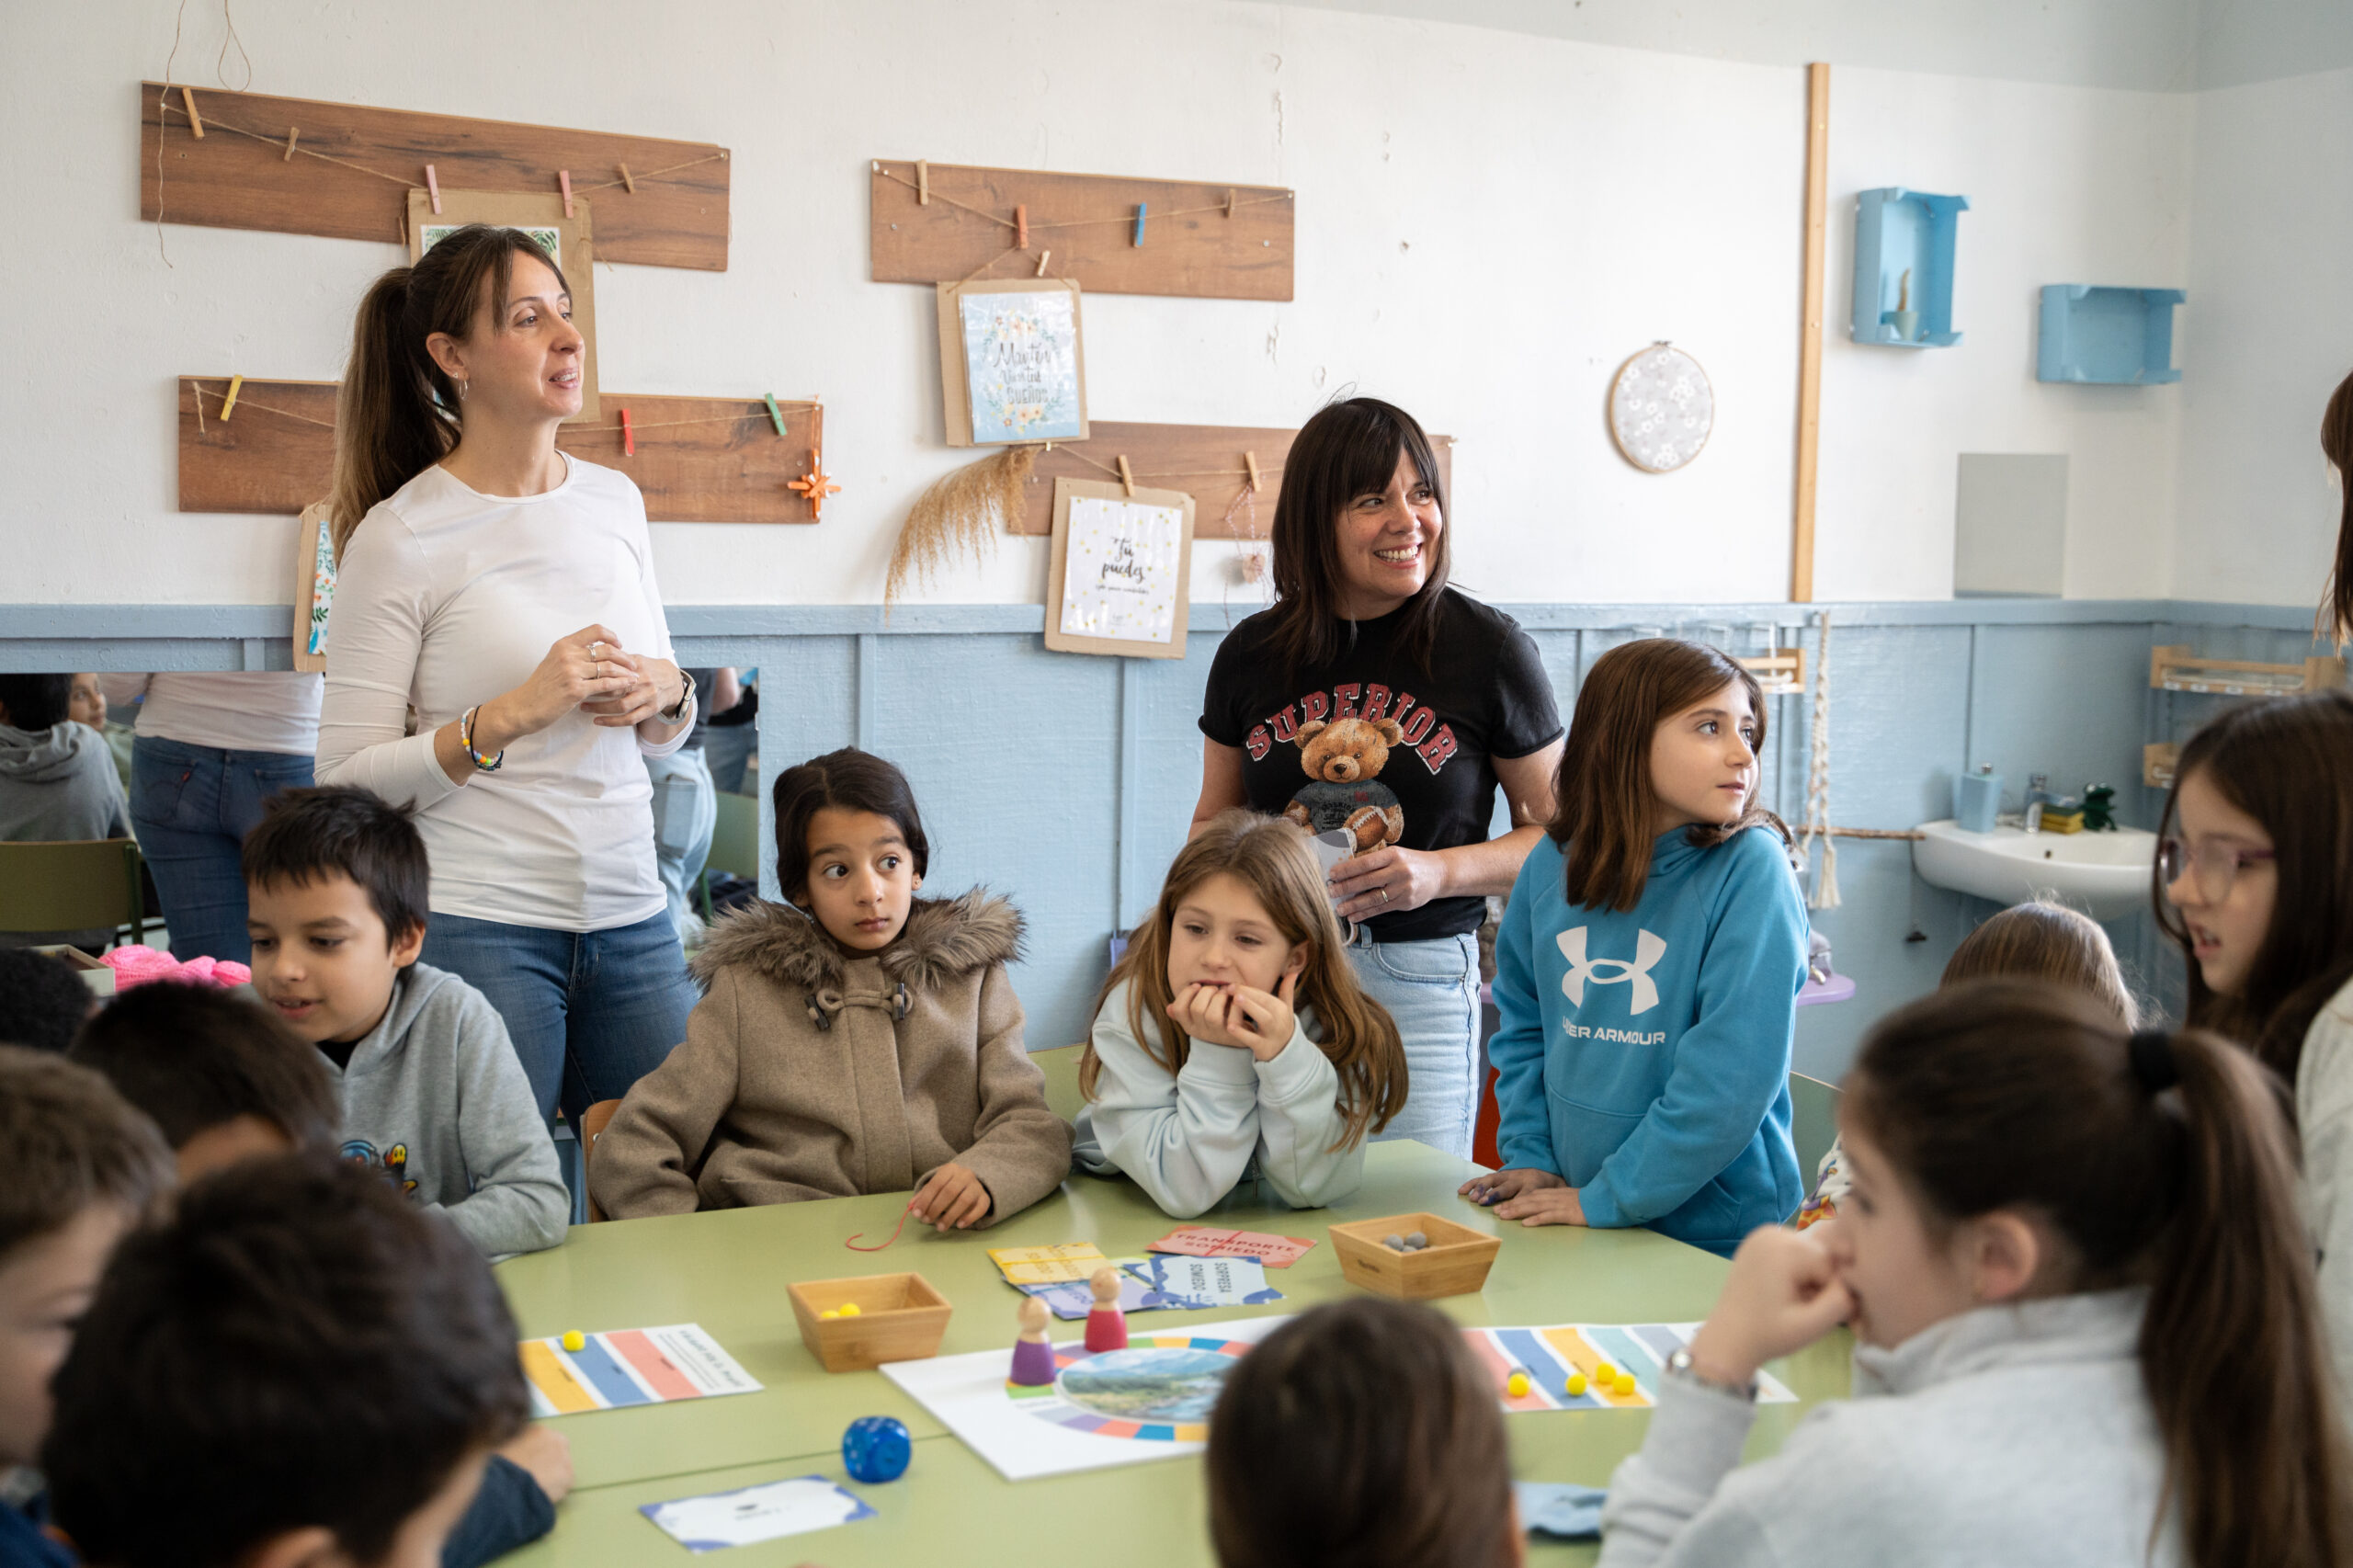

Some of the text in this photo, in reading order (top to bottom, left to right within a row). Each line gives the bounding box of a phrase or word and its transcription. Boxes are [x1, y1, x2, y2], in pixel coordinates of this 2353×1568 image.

[1102, 559, 1145, 584] puedes
[1246, 683, 1458, 775] SUPERIOR
[1594, 1027, 1665, 1045] ARMOUR
[1189, 1263, 1206, 1291] SOMIEDO
[1214, 1262, 1233, 1293] SORPRESA
